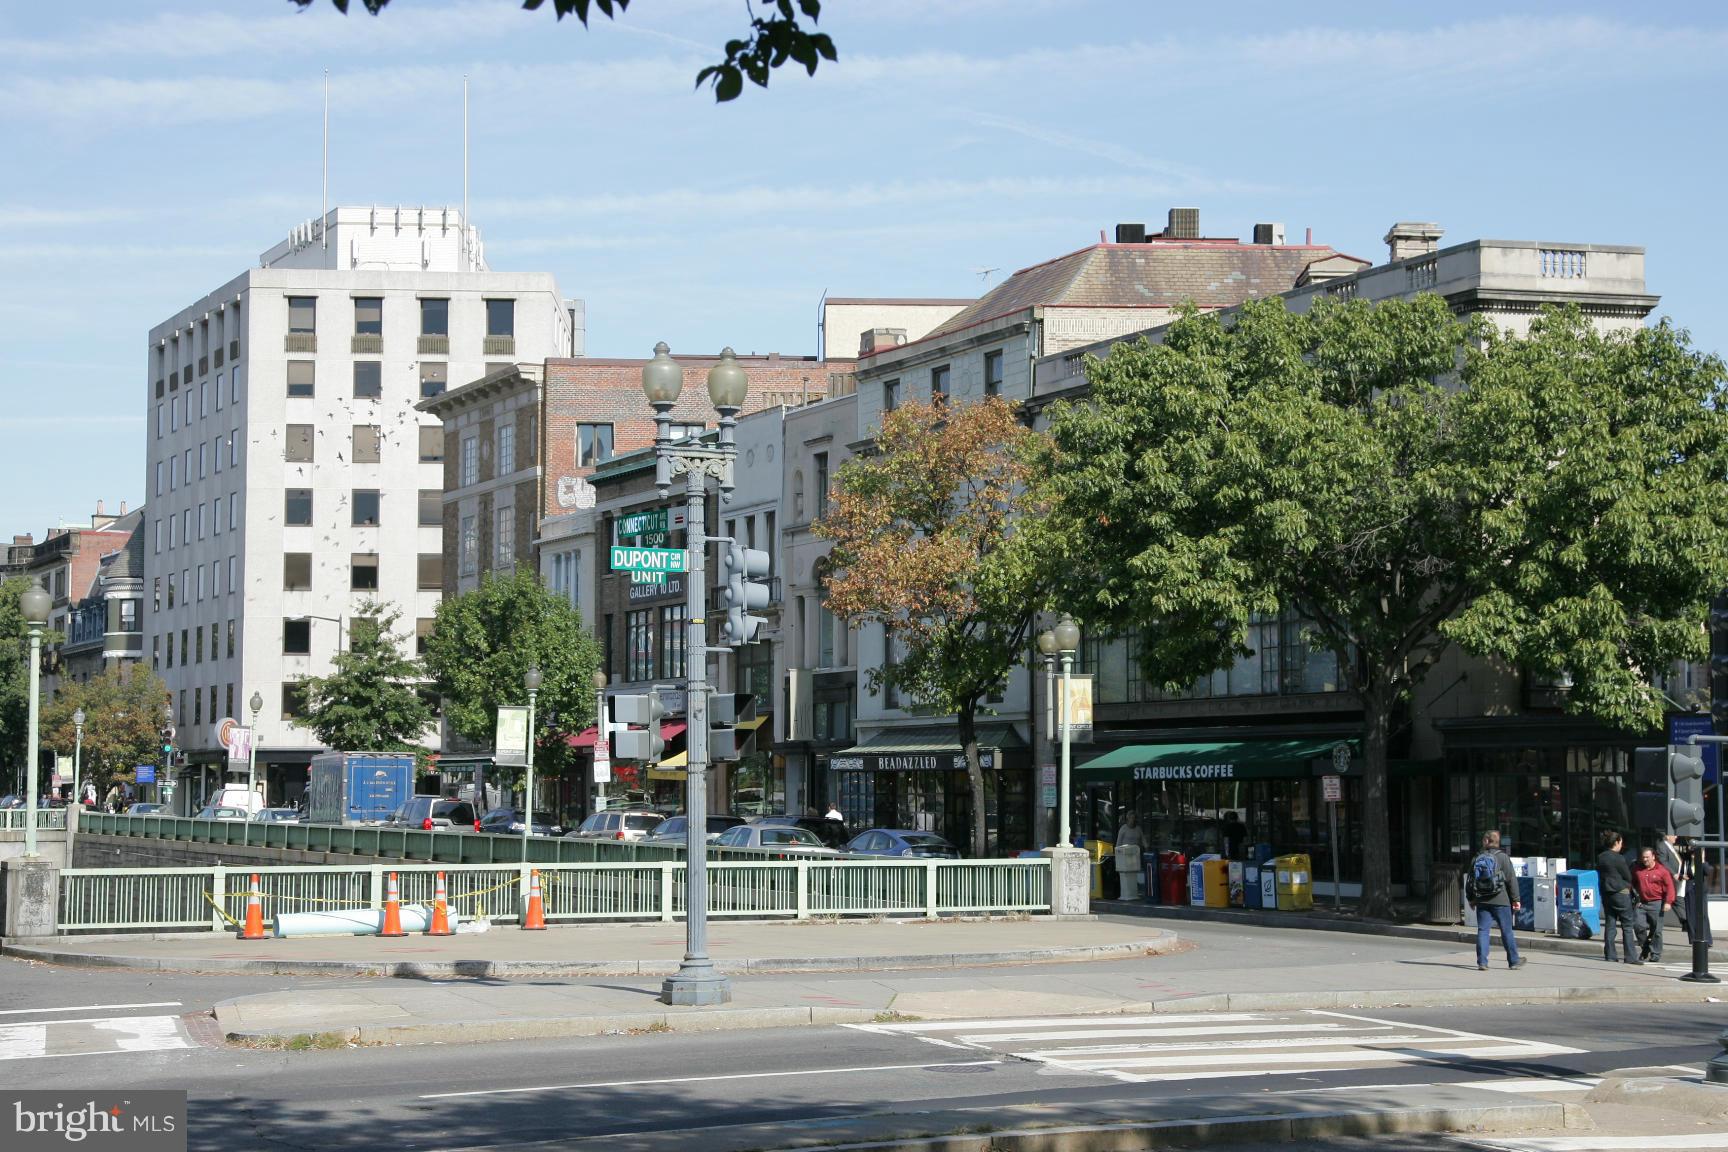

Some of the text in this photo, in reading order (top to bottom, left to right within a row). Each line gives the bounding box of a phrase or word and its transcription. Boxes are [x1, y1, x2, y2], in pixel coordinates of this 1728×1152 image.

[618, 514, 658, 535] CONNECTICUT
[645, 533, 664, 545] 1500
[614, 550, 669, 568] DUPONT
[631, 571, 665, 583] UNIT
[629, 580, 682, 599] GALLERY 10 LTD.
[878, 756, 937, 769] BEADAZZLED
[1133, 764, 1234, 780] STARBUCKS COFFEE
